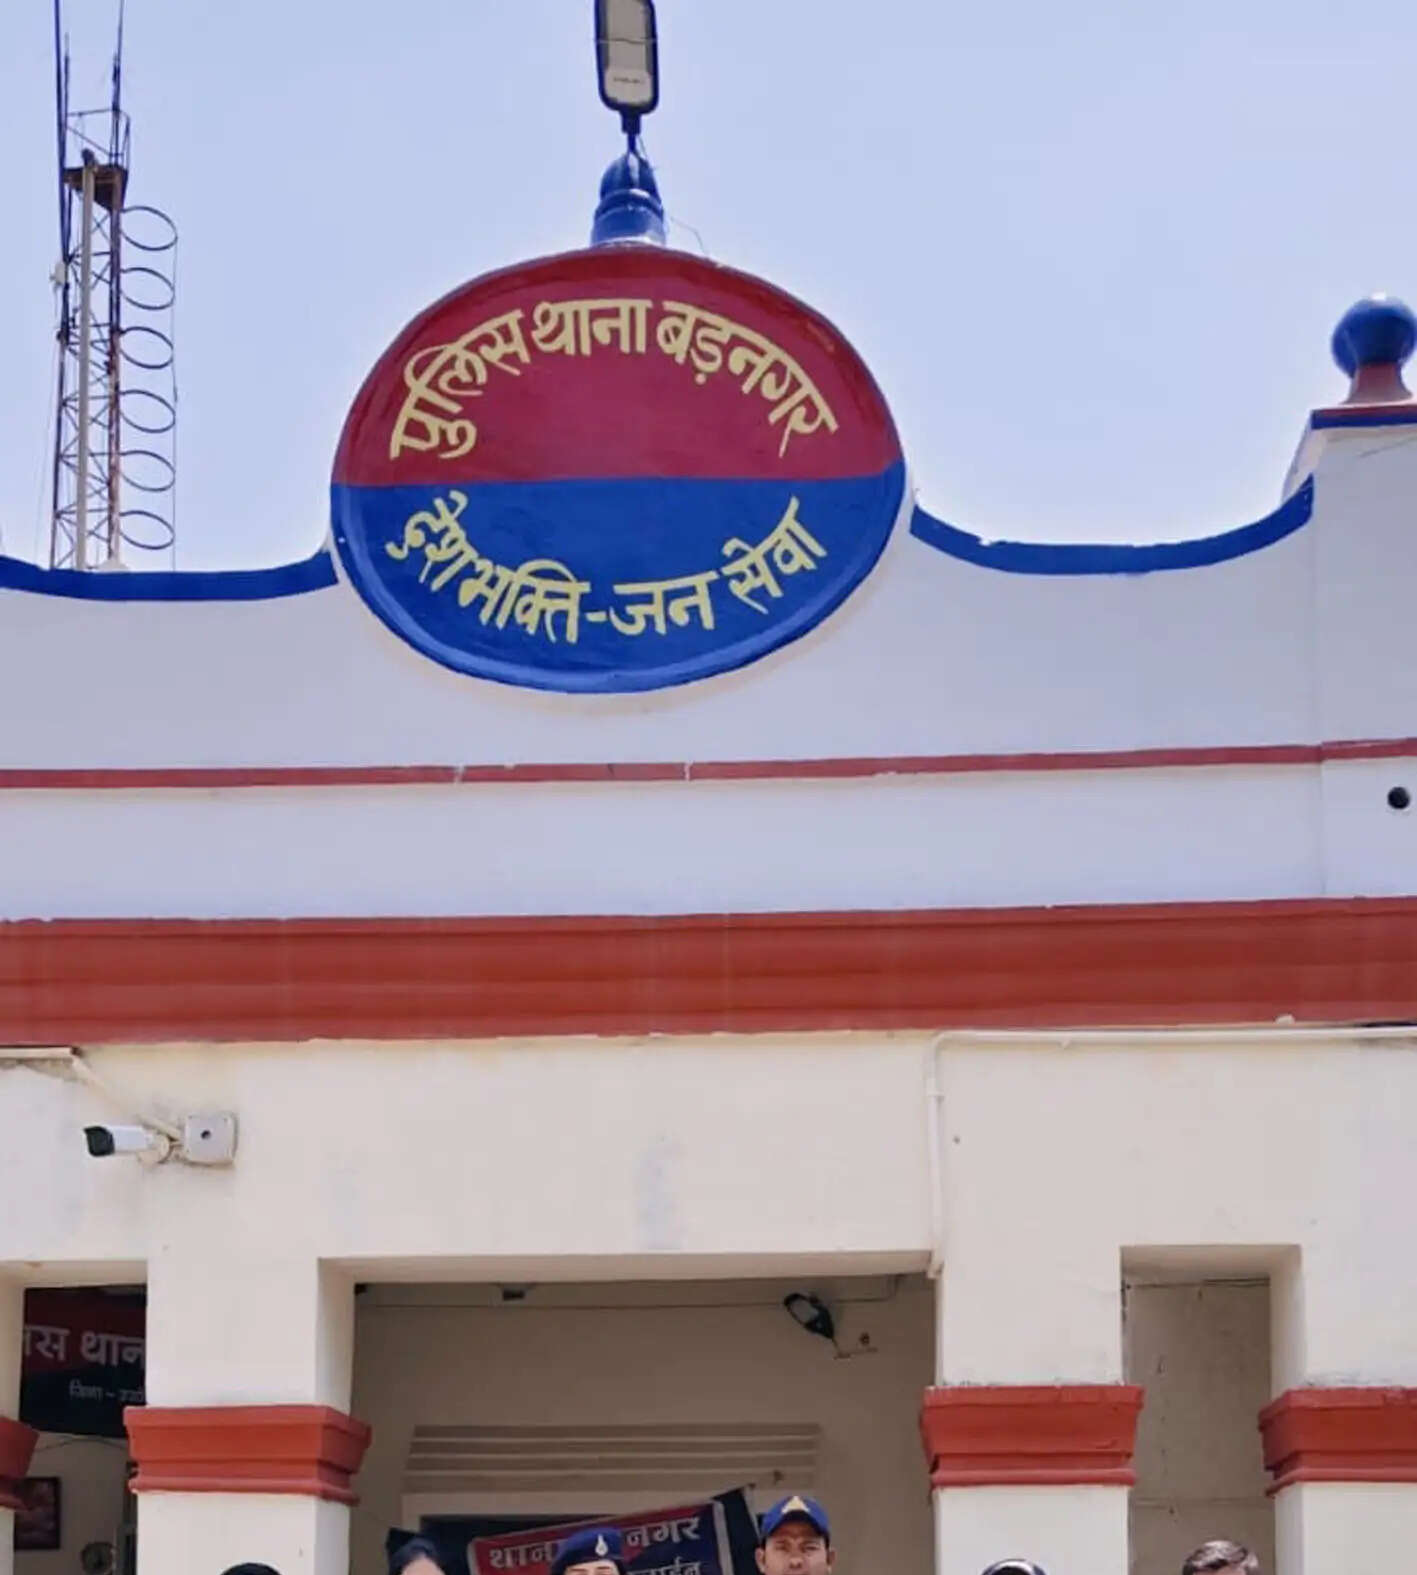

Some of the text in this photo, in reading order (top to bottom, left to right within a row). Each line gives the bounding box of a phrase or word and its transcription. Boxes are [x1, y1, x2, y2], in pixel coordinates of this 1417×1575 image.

[389, 298, 839, 460] पुलिस थाना बड़नगर
[721, 496, 829, 615] सेवा
[79, 1329, 146, 1370] थान
[489, 1515, 701, 1569] थान नगर
